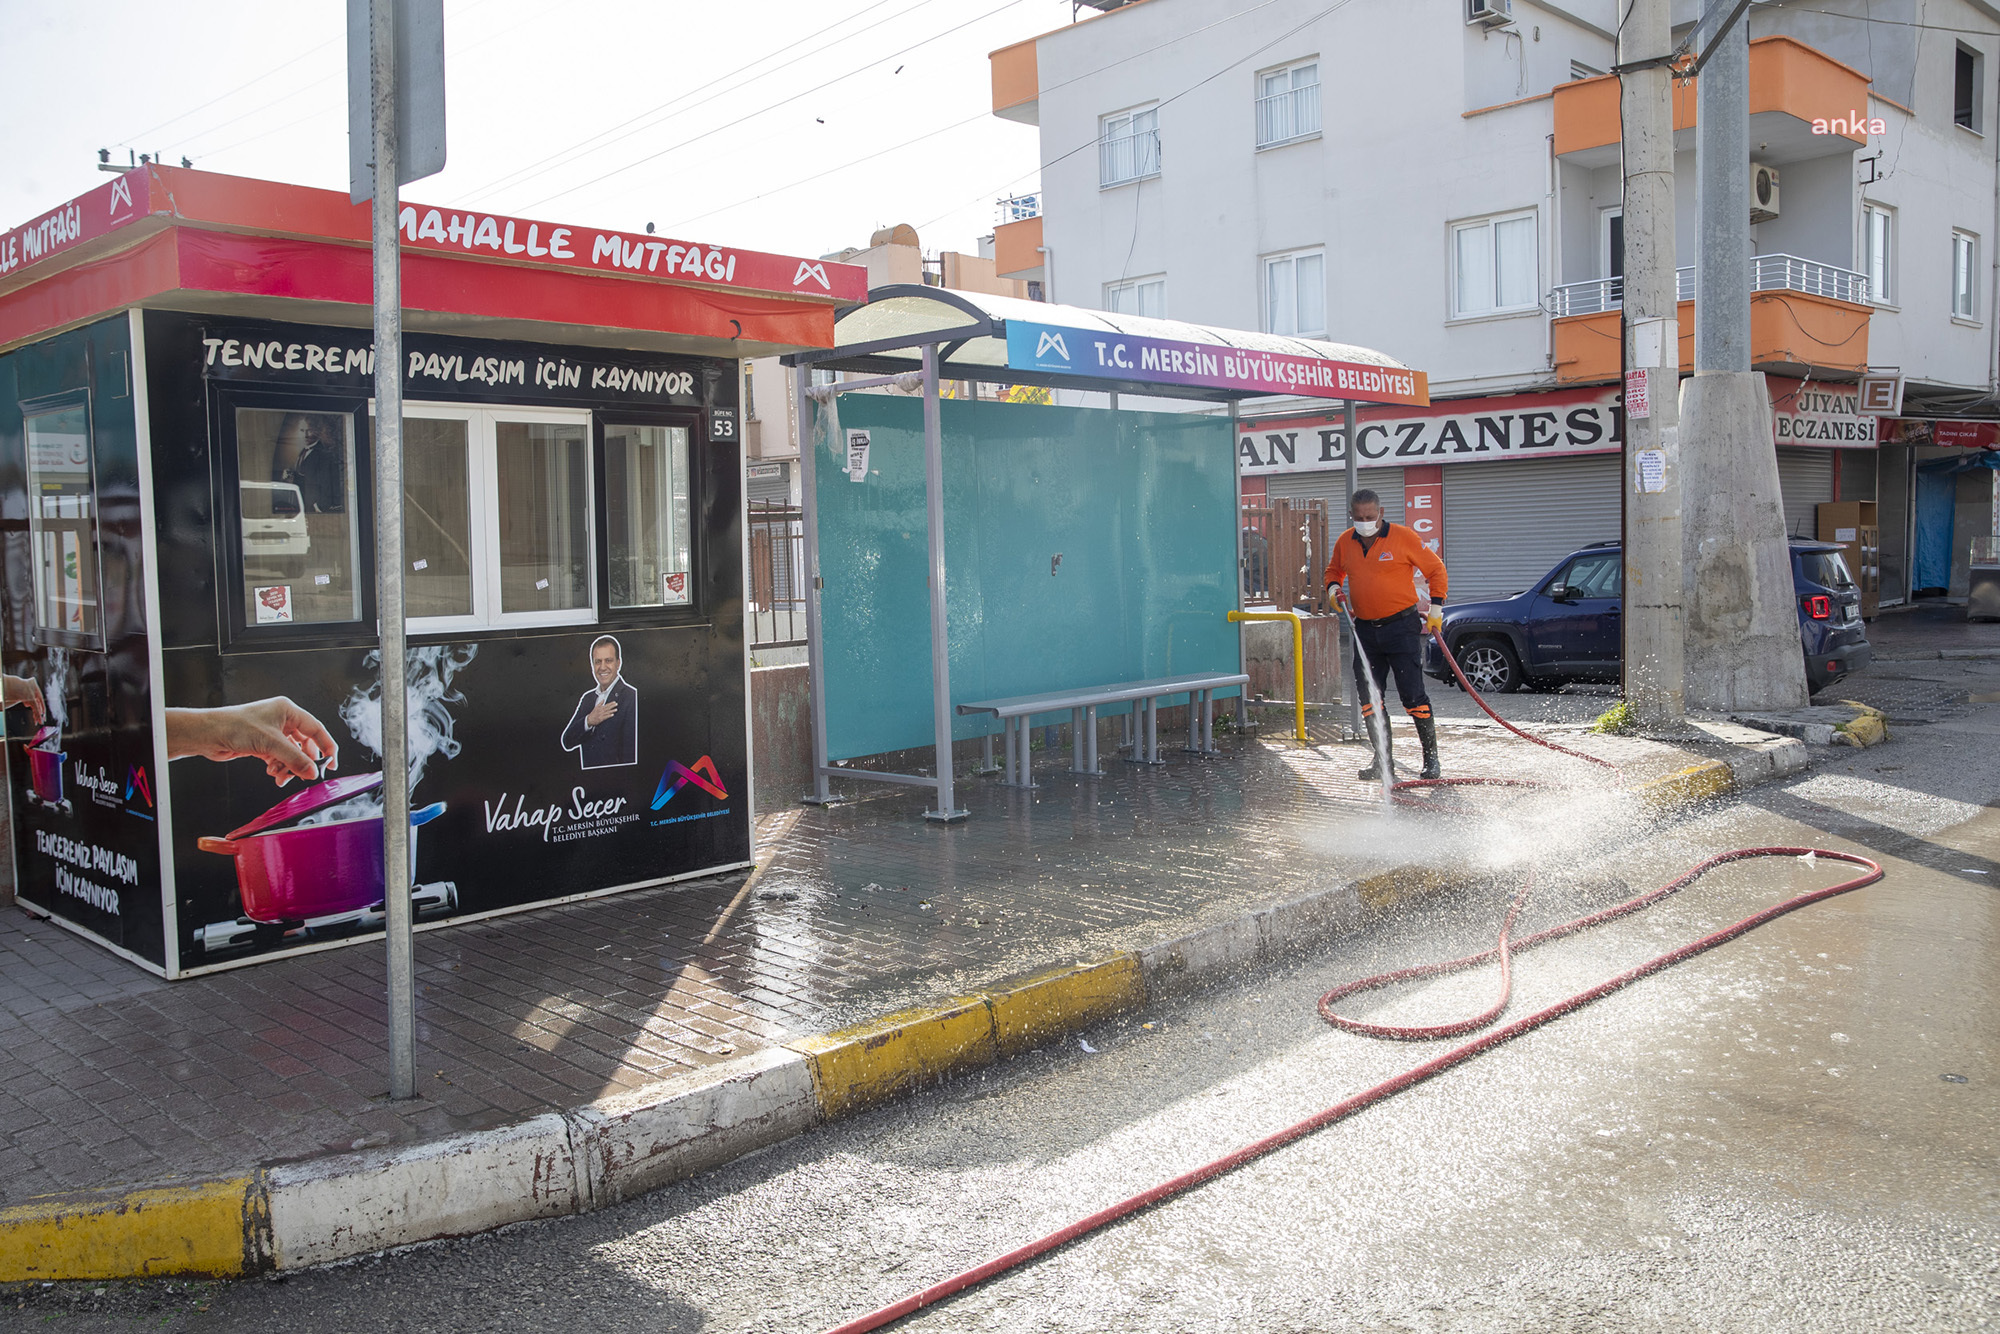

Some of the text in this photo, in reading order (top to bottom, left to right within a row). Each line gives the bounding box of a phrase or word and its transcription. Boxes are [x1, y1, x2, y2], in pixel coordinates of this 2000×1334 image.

[0, 201, 81, 273] LE MUTFAĞI
[592, 234, 736, 282] MUTFAĞI
[203, 338, 694, 396] TENCEREMİ PAYLAŞIM İÇİN KAYNIYOR
[1094, 341, 1416, 397] T.C. MERSİN BÜYÜKŞEHİR BELEDİYESİ
[1799, 387, 1858, 415] JİYAN
[714, 420, 733, 436] 53
[1778, 417, 1875, 441] ECZANESİ
[75, 759, 98, 801] Vahap
[484, 785, 627, 842] Vahap Seçer
[552, 813, 641, 835] T.C. MERSİN BÜYÜKŞEHİR
[553, 826, 618, 844] BELEDİYE BAŞKANI
[659, 816, 678, 826] MERSİN
[36, 829, 139, 886] TENCEREMİZ PAYLAŞIM
[55, 862, 120, 916] İÇİN KAYNIYOR
